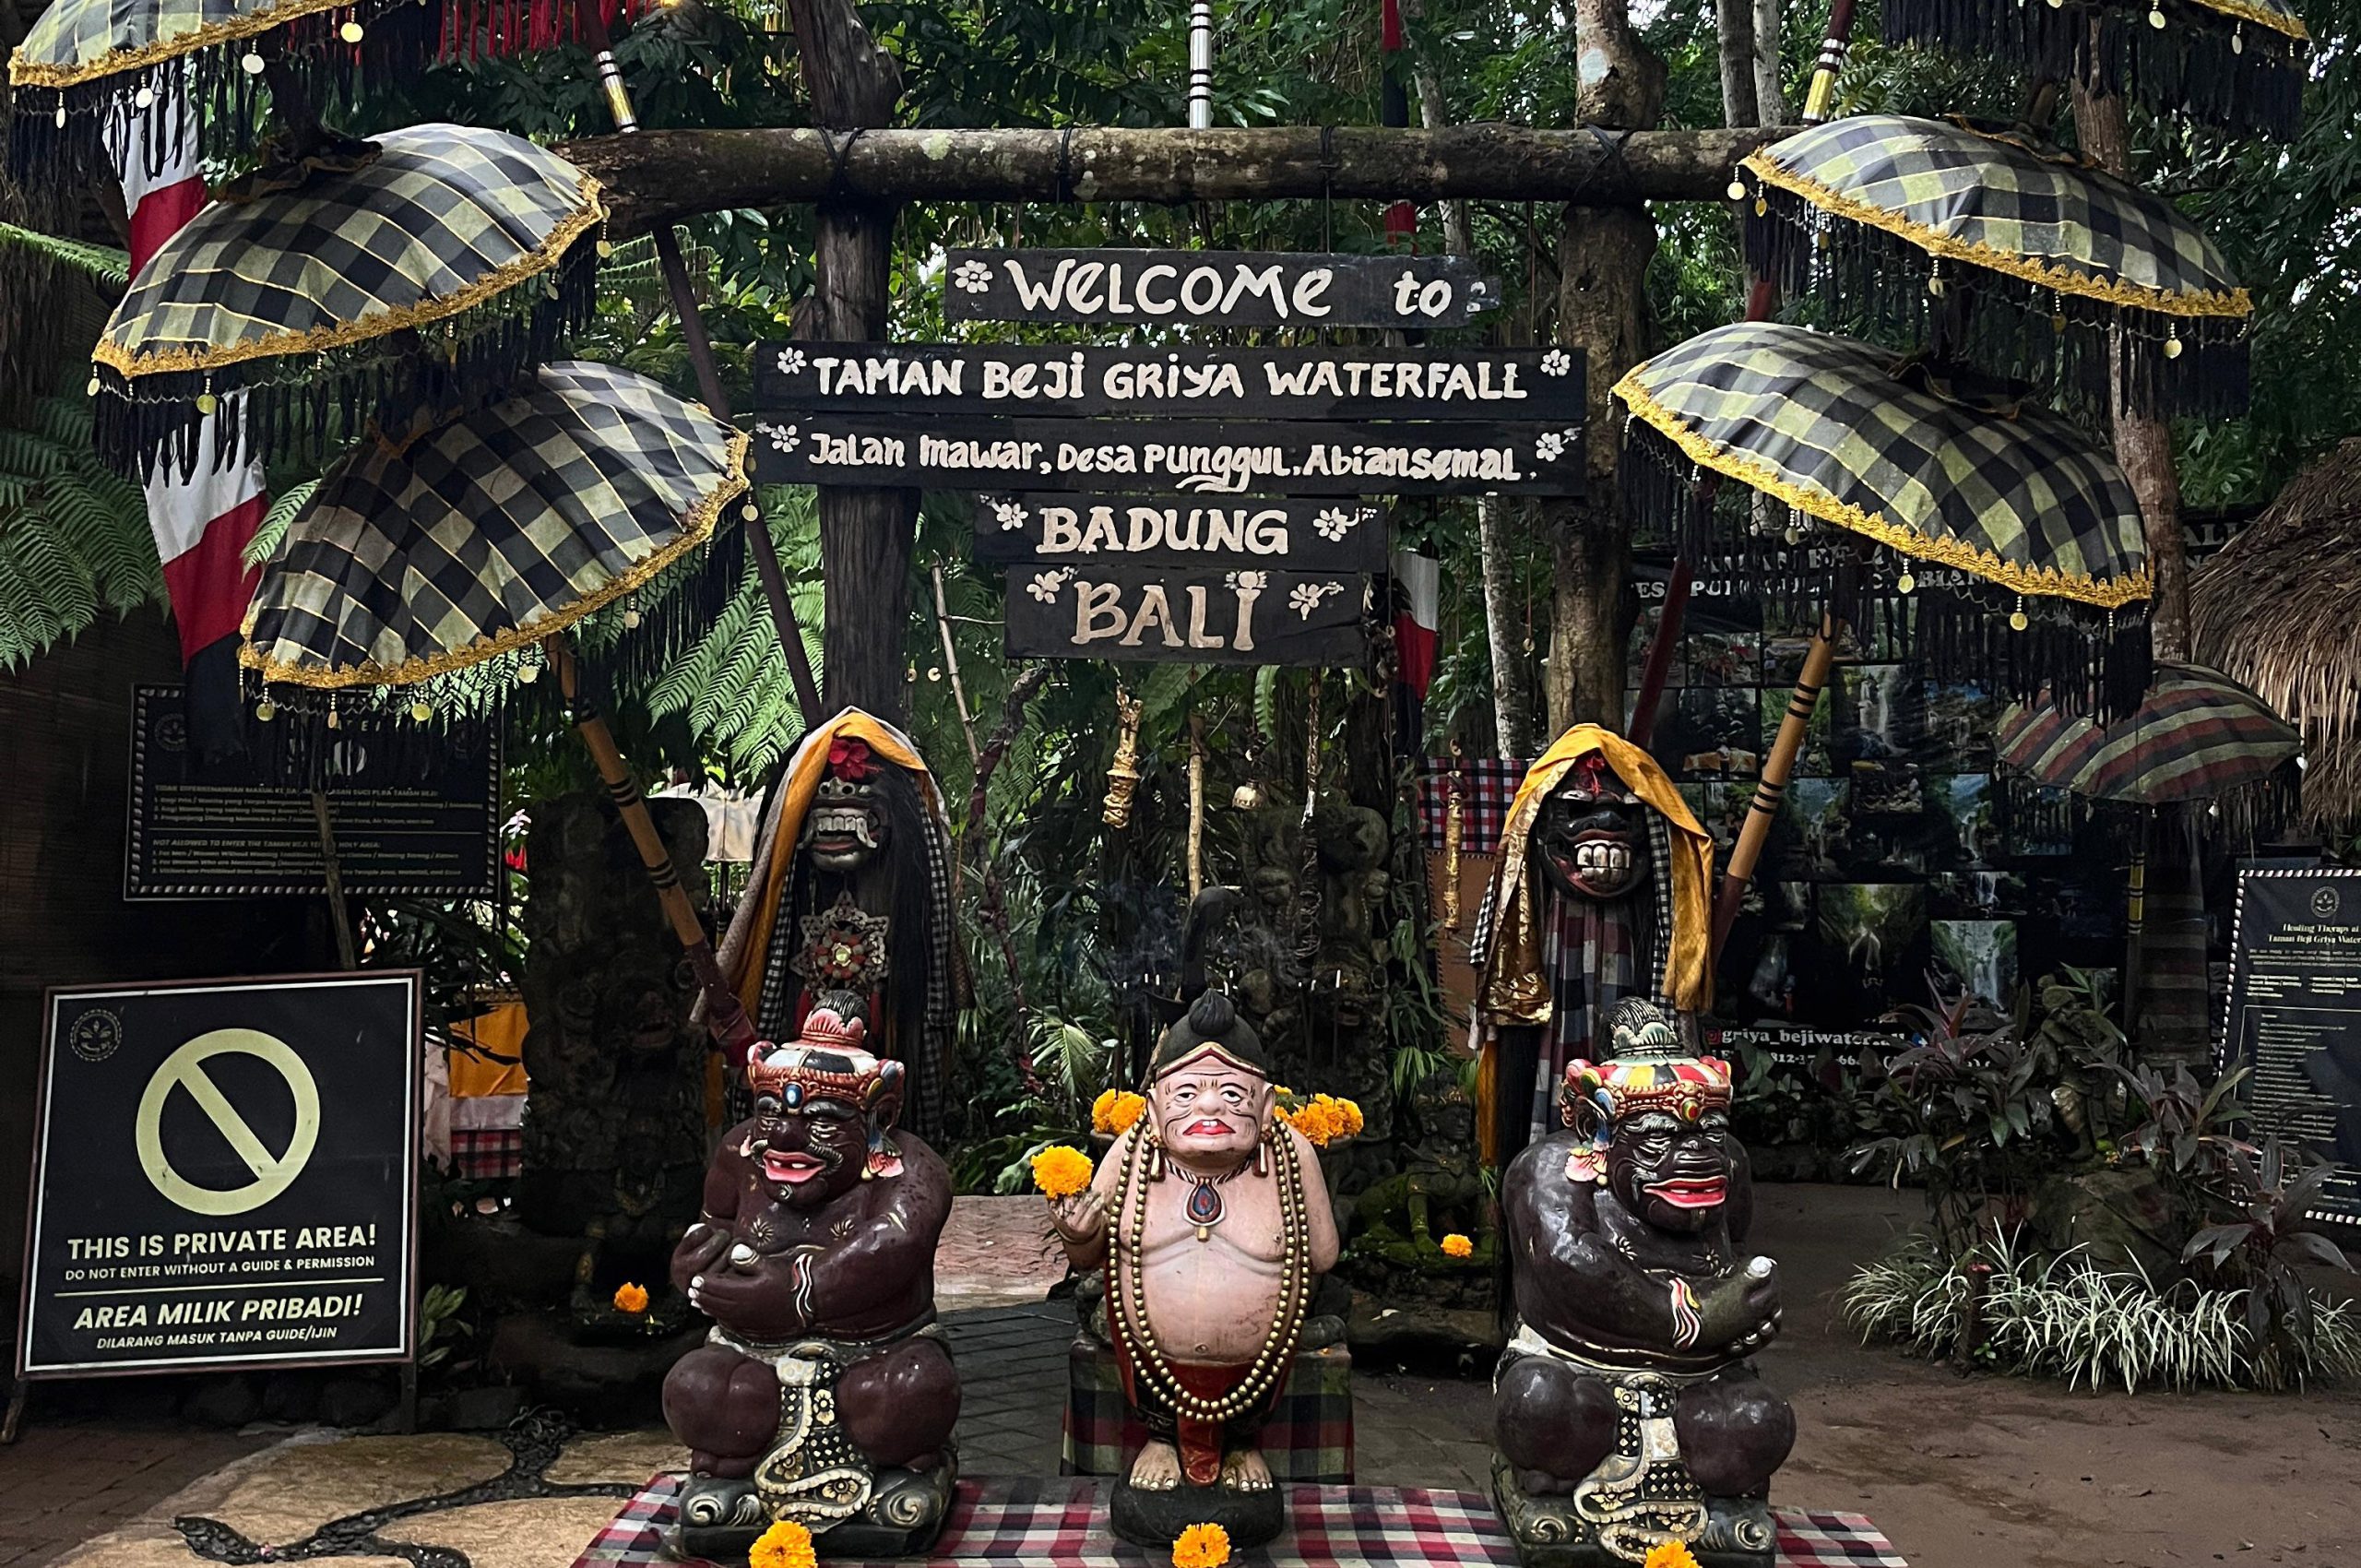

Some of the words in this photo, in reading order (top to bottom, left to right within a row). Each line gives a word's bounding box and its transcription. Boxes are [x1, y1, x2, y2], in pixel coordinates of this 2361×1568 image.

[1394, 270, 1453, 318] to
[812, 356, 966, 397] TAMAN
[1263, 361, 1528, 401] WATERFALL
[1058, 444, 1138, 473] Desa
[1036, 506, 1288, 555] BADUNG
[1070, 572, 1266, 651] BALI
[67, 1236, 130, 1260] THIS
[139, 1234, 164, 1257] IS
[173, 1229, 287, 1255] PRIVATE
[295, 1223, 375, 1250] AREA!
[65, 1269, 86, 1281] DO
[89, 1267, 117, 1279] NOT
[120, 1265, 160, 1278] ENTER
[164, 1262, 226, 1276] WITHOUT
[228, 1262, 238, 1273] A
[241, 1259, 280, 1272] GUIDE
[284, 1259, 292, 1271] &
[296, 1255, 374, 1270] PERMISSION
[73, 1305, 148, 1330] AREA
[157, 1301, 235, 1325] MILIK
[241, 1293, 363, 1322] PRIBADI!
[96, 1335, 164, 1349] DILARANG
[166, 1332, 217, 1346] MASUK
[219, 1330, 262, 1343] TANPA
[266, 1325, 338, 1342] GUIDE/IJIN
